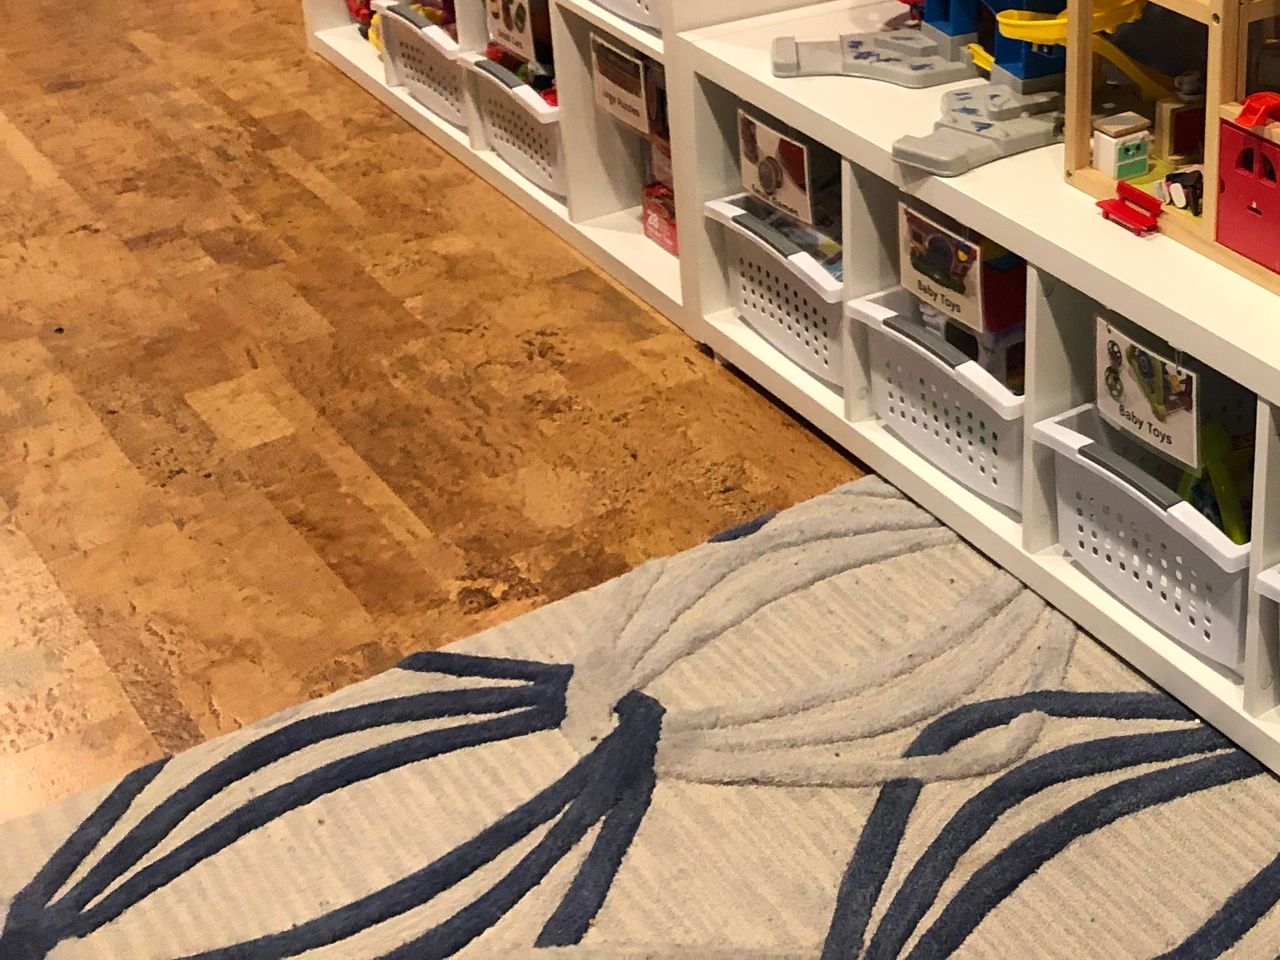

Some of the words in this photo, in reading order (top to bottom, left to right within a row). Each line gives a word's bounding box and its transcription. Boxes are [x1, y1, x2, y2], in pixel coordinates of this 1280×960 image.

[917, 279, 938, 302] Baby
[939, 293, 962, 313] Toys
[1119, 404, 1144, 430] Baby
[1146, 421, 1173, 445] Toys
